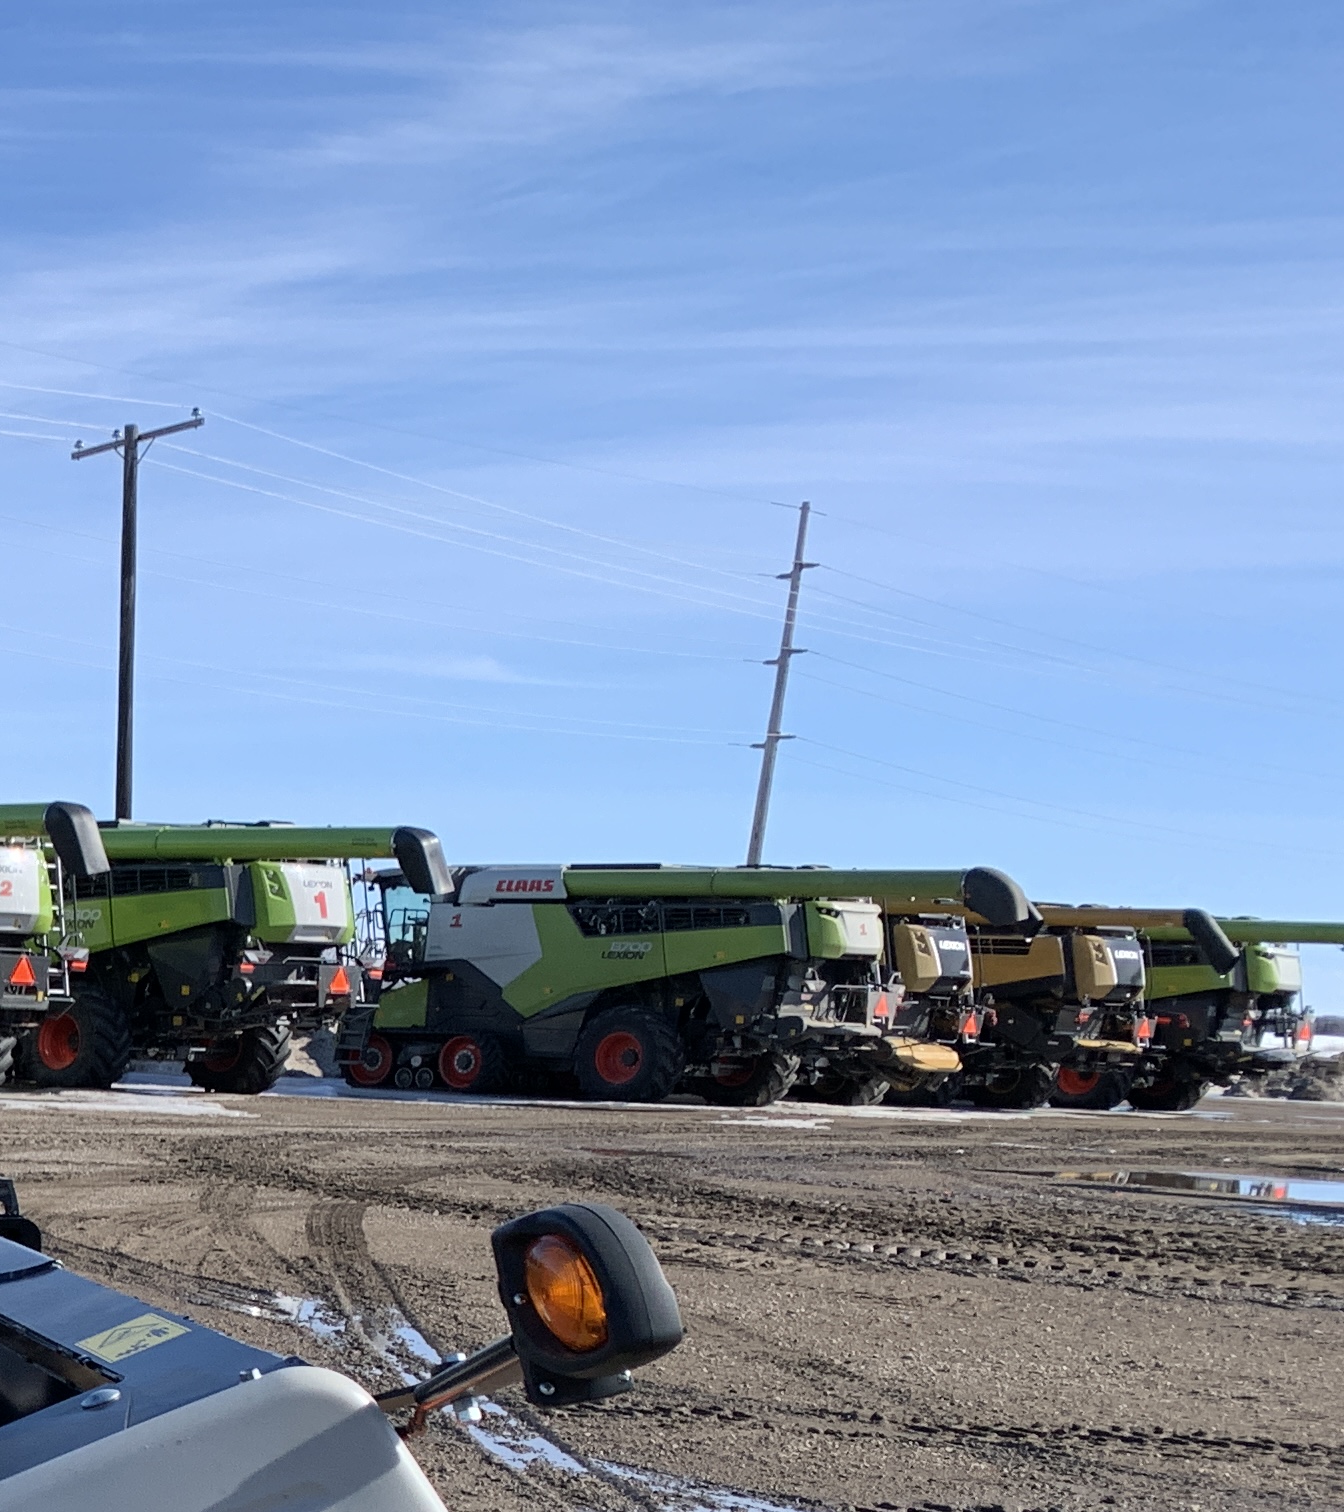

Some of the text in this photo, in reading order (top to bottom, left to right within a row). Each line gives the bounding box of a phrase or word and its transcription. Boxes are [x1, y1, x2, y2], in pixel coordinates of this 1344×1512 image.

[0, 880, 13, 897] 2
[495, 880, 555, 892] CLAAS
[314, 891, 328, 919] 1
[449, 913, 463, 928] 1
[859, 923, 867, 936] 1
[601, 951, 645, 960] LEXION
